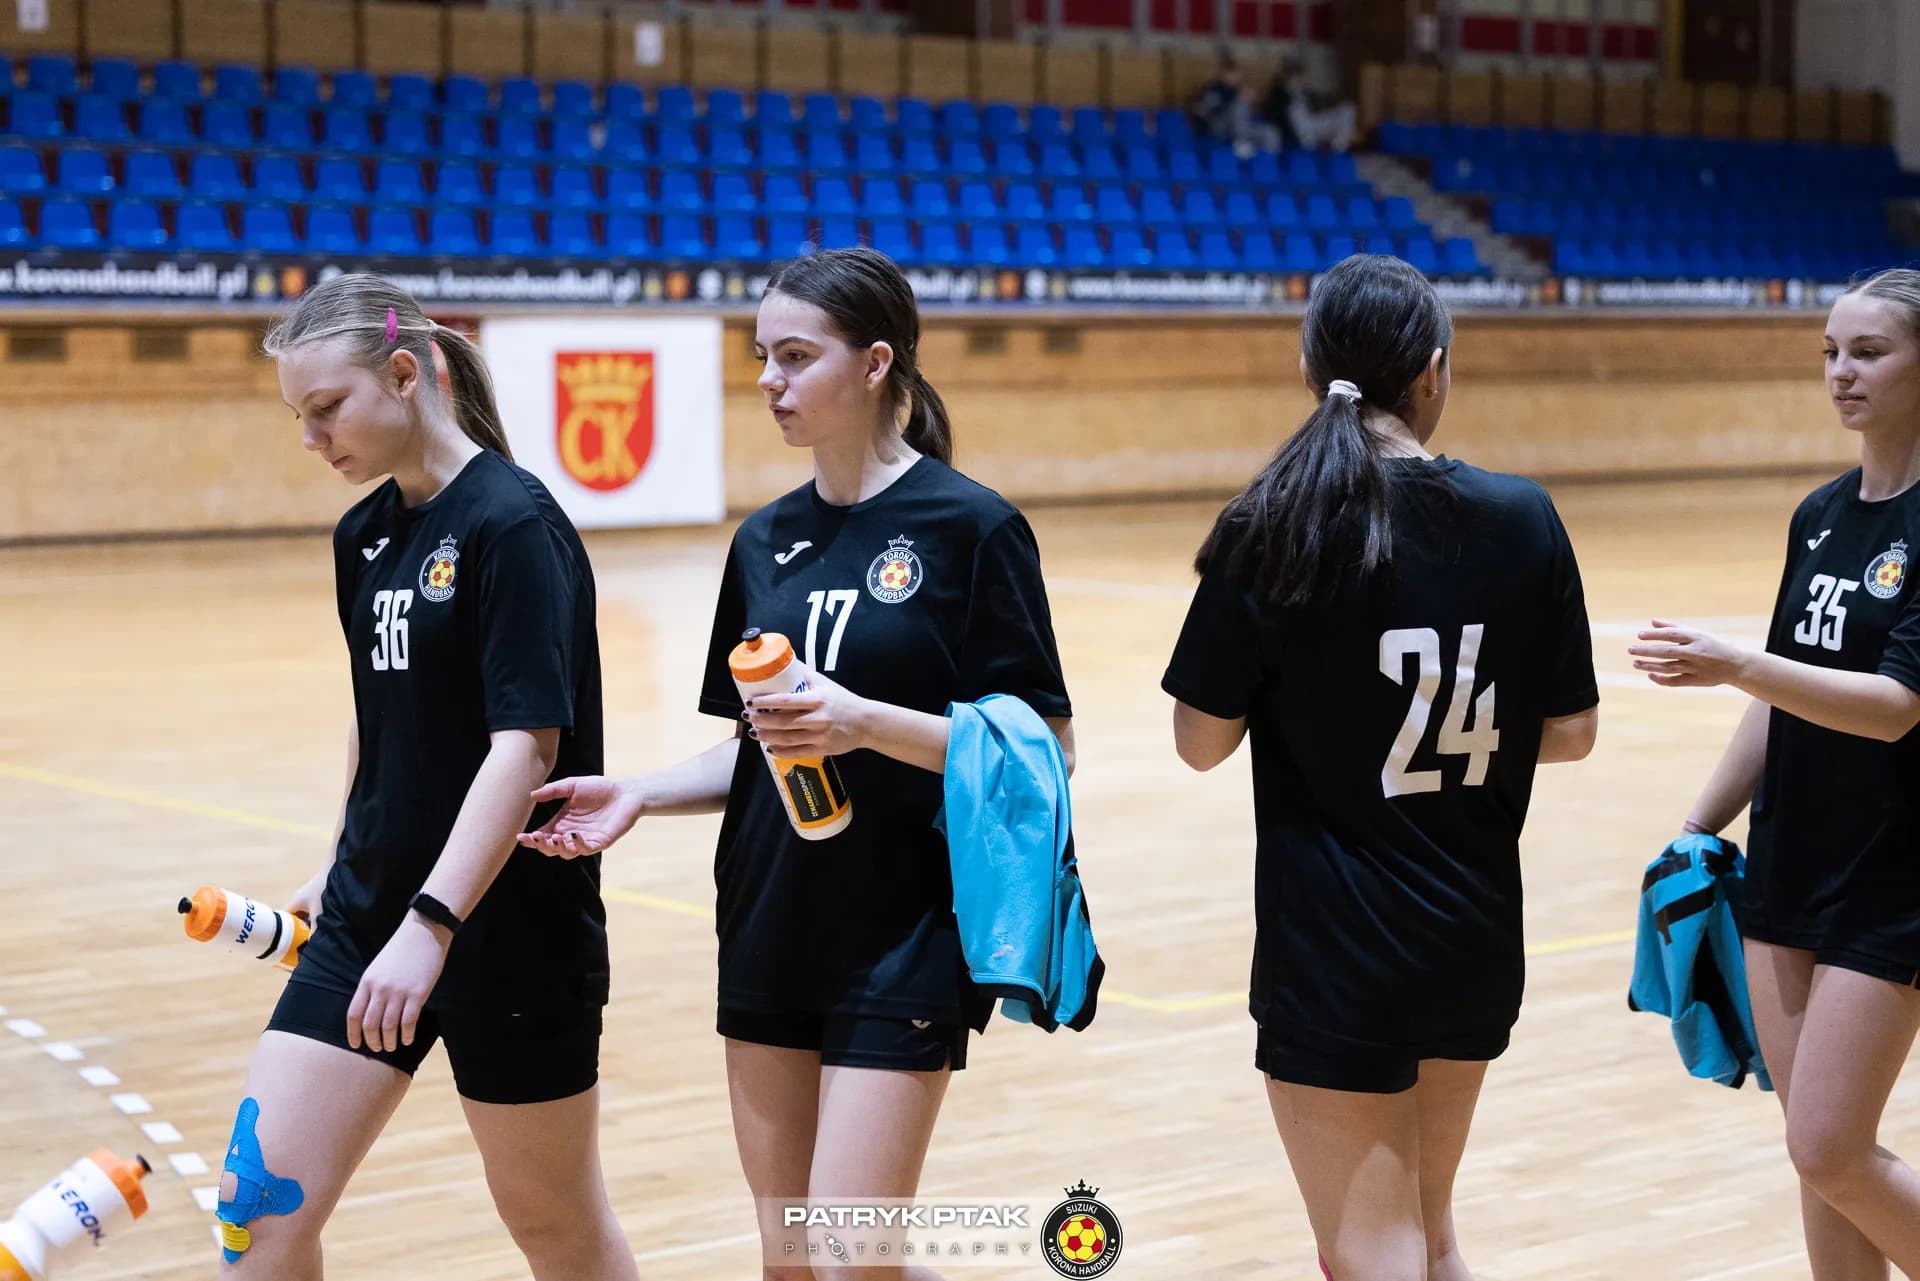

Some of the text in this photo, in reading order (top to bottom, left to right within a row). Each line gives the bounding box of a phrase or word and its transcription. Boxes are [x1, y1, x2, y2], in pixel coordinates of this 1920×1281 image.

[434, 550, 457, 562] KORONA
[874, 585, 912, 600] HANDBALL
[883, 551, 914, 564] KORONA
[371, 589, 414, 671] 36
[805, 589, 859, 672] 17
[1794, 573, 1860, 652] 35
[1379, 624, 1500, 799] 24
